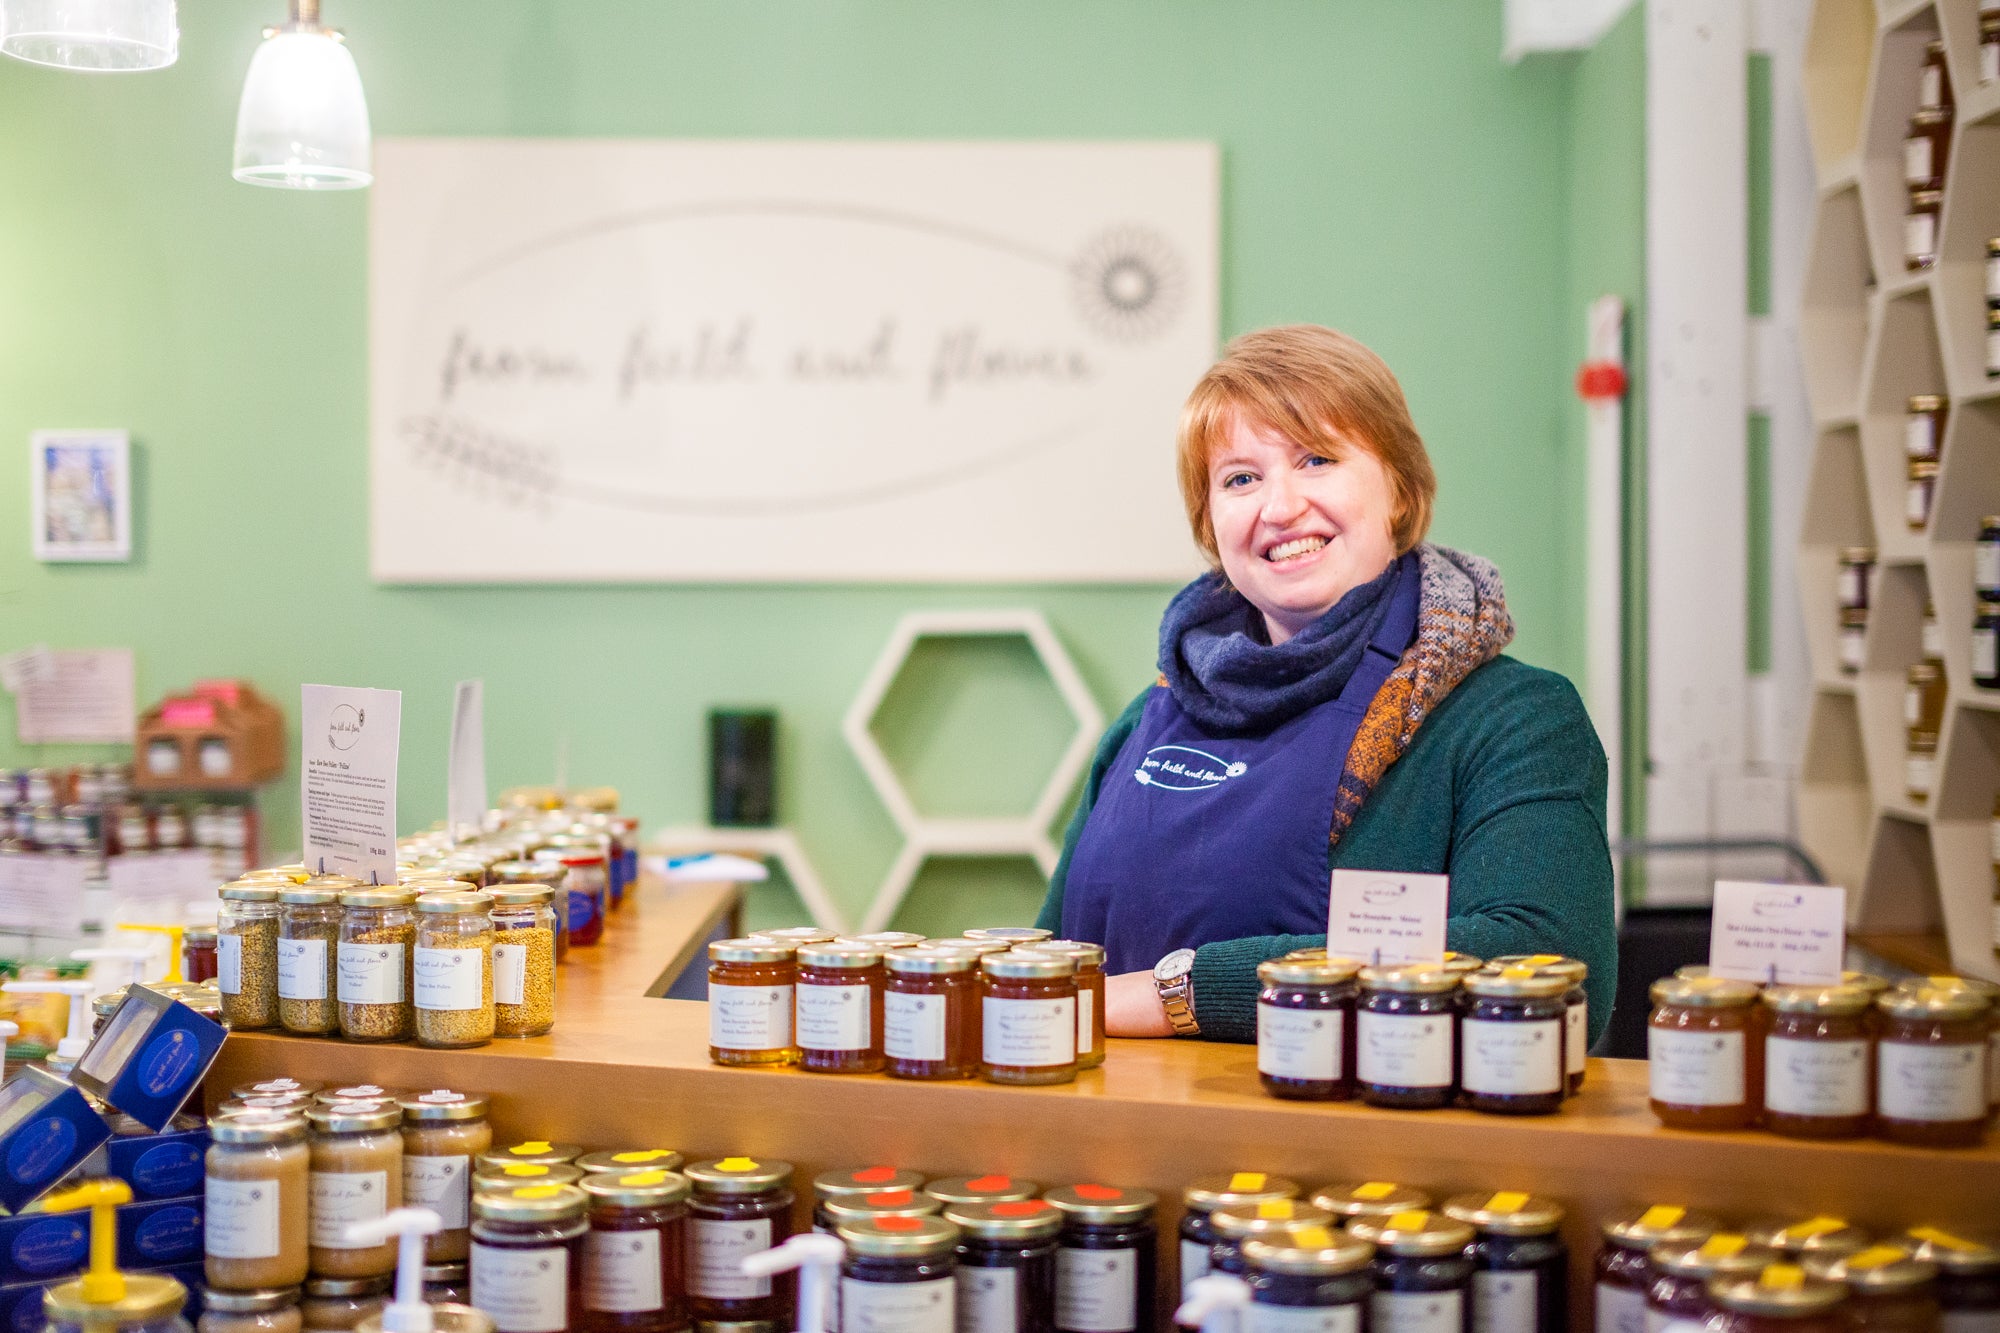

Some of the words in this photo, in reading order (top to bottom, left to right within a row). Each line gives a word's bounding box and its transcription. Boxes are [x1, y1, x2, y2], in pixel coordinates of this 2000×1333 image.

[438, 324, 587, 400] from
[616, 318, 756, 402] field
[785, 318, 902, 386] and
[926, 322, 1104, 404] flower
[1141, 757, 1160, 769] from
[1161, 760, 1185, 774] field
[1184, 769, 1204, 779] and
[1201, 771, 1227, 781] flower
